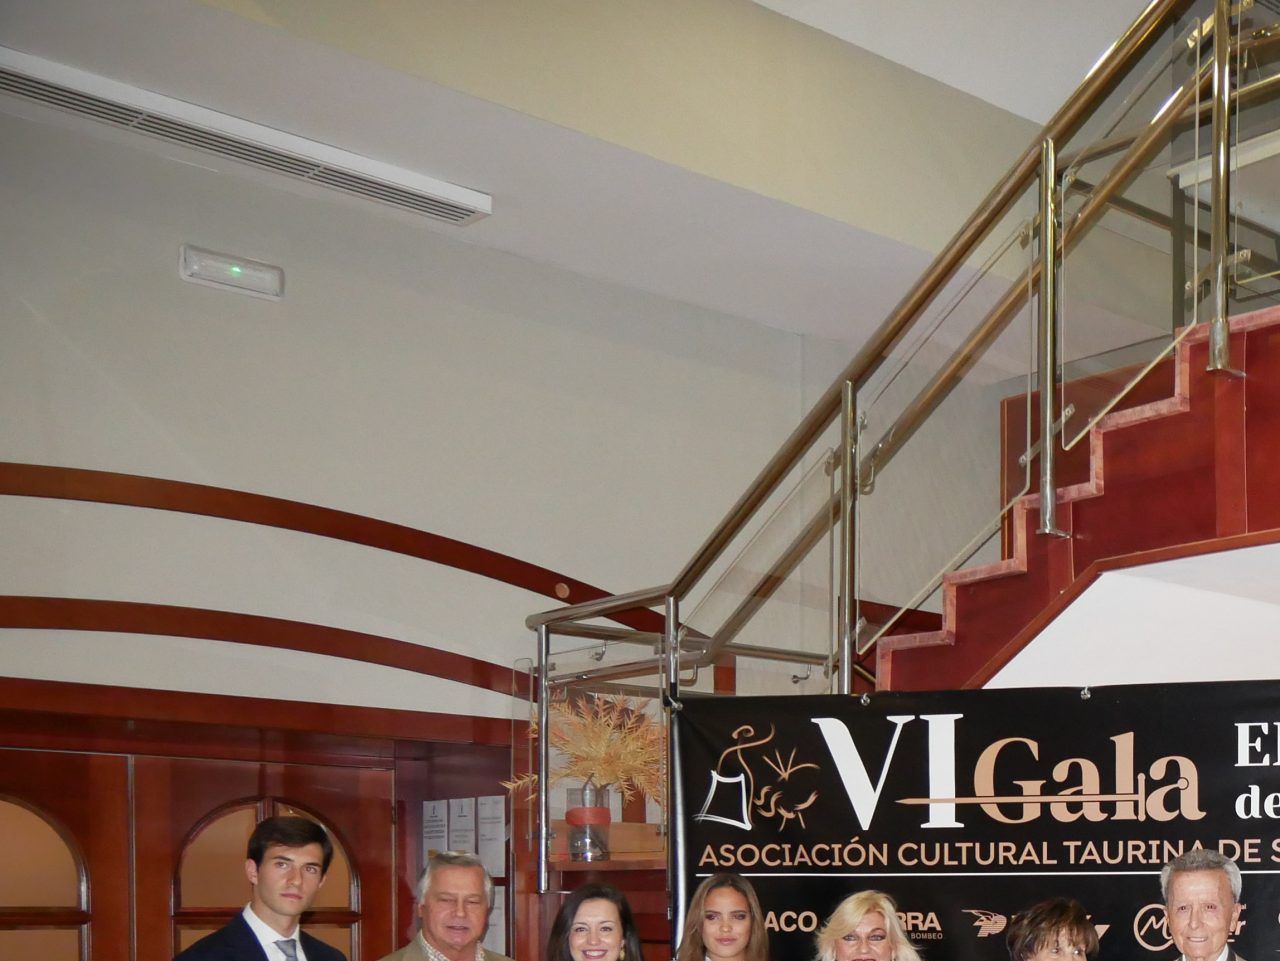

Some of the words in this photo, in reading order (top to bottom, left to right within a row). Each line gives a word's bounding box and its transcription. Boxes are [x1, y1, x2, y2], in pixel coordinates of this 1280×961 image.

[811, 714, 964, 831] VI
[973, 731, 1207, 824] Gala
[699, 836, 888, 867] ASOCIACIÓN
[898, 841, 1057, 866] CULTURAL
[1218, 838, 1261, 863] DE
[764, 911, 818, 932] ACO
[911, 932, 943, 940] BOMBEO
